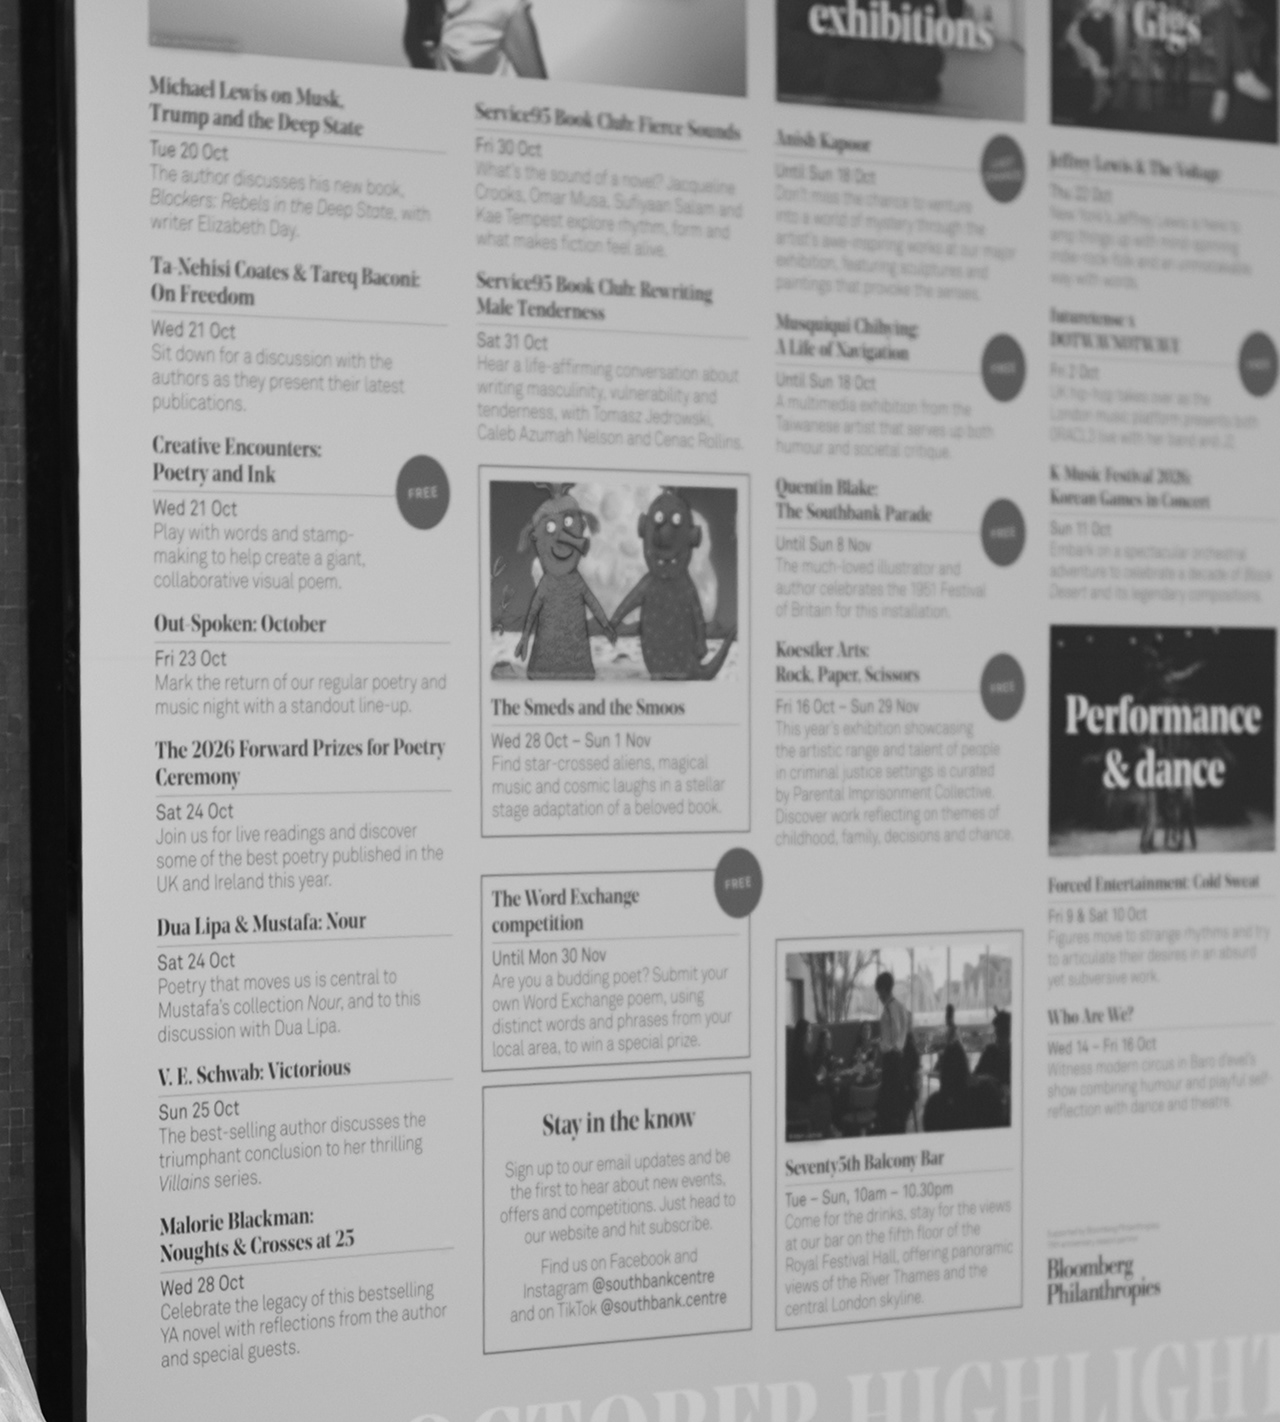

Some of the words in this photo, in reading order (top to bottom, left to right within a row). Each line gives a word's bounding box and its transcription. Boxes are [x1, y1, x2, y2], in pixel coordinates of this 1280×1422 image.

[808, 0, 994, 50] exhibitions
[1133, 0, 1202, 55] Gigs
[149, 76, 215, 98] Michael
[220, 81, 268, 102] Lewis
[271, 90, 292, 105] on
[149, 103, 209, 130] Trump
[213, 109, 244, 128] and
[248, 110, 273, 130] the
[278, 112, 320, 138] Deep
[323, 116, 364, 137] State
[149, 139, 176, 158] Tue
[180, 141, 198, 160] 20
[202, 142, 229, 162] Oct
[234, 259, 289, 281] Coates
[292, 263, 307, 282] &
[313, 264, 358, 290] Tareq
[150, 283, 176, 302] On
[180, 285, 255, 306] Freedom
[476, 272, 552, 292] Service95
[556, 275, 595, 295] Book
[640, 281, 714, 306] Rewriting
[477, 297, 513, 316] Male
[519, 299, 606, 320] Tenderness
[151, 320, 184, 338] Wed
[189, 321, 204, 339] 21
[210, 321, 236, 340] Oct
[152, 435, 221, 455] Creative
[225, 437, 322, 457] Encounters:
[153, 462, 208, 486] Poetry
[212, 464, 243, 483] and
[248, 465, 276, 483] Ink
[408, 486, 437, 499] FREE
[775, 478, 833, 499] Quentin
[776, 502, 802, 519] The
[806, 504, 881, 521] Southbank
[885, 505, 932, 523] Parade
[153, 613, 257, 637] Out-Spoken:
[260, 613, 326, 633] October
[776, 641, 833, 658] Koestler
[775, 665, 814, 684] Rock,
[818, 665, 862, 687] Paper,
[865, 666, 920, 682] Scissors
[491, 698, 520, 716] The
[524, 698, 575, 716] Smeds
[578, 698, 606, 716] and
[610, 698, 632, 716] the
[636, 699, 686, 715] Smoos
[1066, 695, 1262, 734] Performance
[155, 740, 188, 759] The
[192, 740, 235, 759] 2026
[240, 739, 308, 758] Forward
[313, 739, 363, 757] Prizes
[367, 738, 389, 756] for
[394, 738, 445, 759] Poetry
[491, 733, 521, 749] Wed
[525, 732, 541, 749] 28
[544, 732, 568, 749] Oct
[585, 731, 610, 749] Sun
[615, 732, 620, 748] 1
[626, 732, 651, 748] Nov
[155, 768, 240, 789] Ceremony
[1103, 750, 1129, 789] &
[1135, 748, 1225, 792] dance
[725, 876, 751, 889] FREE
[1048, 877, 1092, 893] Forced
[1193, 873, 1221, 889] Cold
[1224, 874, 1260, 888] Sweat
[492, 890, 521, 908] The
[525, 888, 566, 906] Word
[571, 888, 640, 907] Exchange
[158, 919, 190, 937] Dua
[196, 917, 230, 940] Lipa
[235, 916, 248, 933] &
[253, 913, 322, 932] Mustafa:
[327, 912, 366, 930] Nour
[491, 915, 584, 937] competition
[157, 954, 183, 971] Sat
[188, 952, 205, 970] 24
[209, 951, 235, 969] Oct
[492, 949, 524, 967] Until
[528, 948, 557, 965] Mon
[562, 947, 578, 964] 30
[581, 947, 607, 963] Nov
[1047, 1008, 1079, 1025] Who
[1084, 1008, 1104, 1024] Are
[1107, 1006, 1134, 1022] We?
[158, 1068, 172, 1086] V.
[178, 1067, 192, 1085] E.
[197, 1063, 263, 1083] Schwab:
[268, 1060, 351, 1079] Victorious
[542, 1114, 581, 1141] Stay
[587, 1112, 605, 1133] in
[610, 1109, 639, 1132] the
[644, 1108, 695, 1130] know
[785, 1155, 861, 1176] Seventy5th
[864, 1153, 916, 1171] Balcony
[921, 1150, 945, 1166] Bar
[160, 1214, 223, 1235] Malorie
[229, 1210, 313, 1229] Blackman:
[160, 1241, 229, 1264] Noughts
[233, 1238, 246, 1256] &
[250, 1237, 312, 1254] Crosses
[316, 1234, 330, 1249] at
[336, 1229, 355, 1247] 25
[541, 1257, 569, 1274] Find
[572, 1259, 588, 1273] us
[590, 1257, 607, 1271] on
[610, 1250, 671, 1269] Facebook
[674, 1248, 698, 1264] and
[1047, 1255, 1134, 1280] Bloomberg
[160, 1278, 193, 1296] Wed
[197, 1275, 215, 1294] 28
[219, 1274, 244, 1291] Oct
[524, 1282, 588, 1301] Instagram
[592, 1271, 715, 1294] @southbankcentre
[1047, 1276, 1161, 1305] Philanthropies
[160, 1300, 231, 1320] Celebrate
[235, 1296, 259, 1313] the
[262, 1295, 307, 1314] legacy
[311, 1288, 325, 1307] of
[328, 1288, 354, 1305] this
[358, 1282, 434, 1302] bestselling
[510, 1305, 535, 1323] and
[539, 1307, 553, 1320] on
[558, 1300, 596, 1317] TikTok
[600, 1292, 727, 1316] @southbank.centre
[160, 1326, 179, 1344] YA
[182, 1322, 221, 1342] novel
[224, 1319, 255, 1337] with
[259, 1314, 335, 1334] reflections
[339, 1310, 371, 1326] from
[375, 1307, 398, 1324] the
[401, 1303, 447, 1321] author
[161, 1349, 189, 1368] and
[193, 1344, 244, 1367] special
[248, 1341, 300, 1364] guests.
